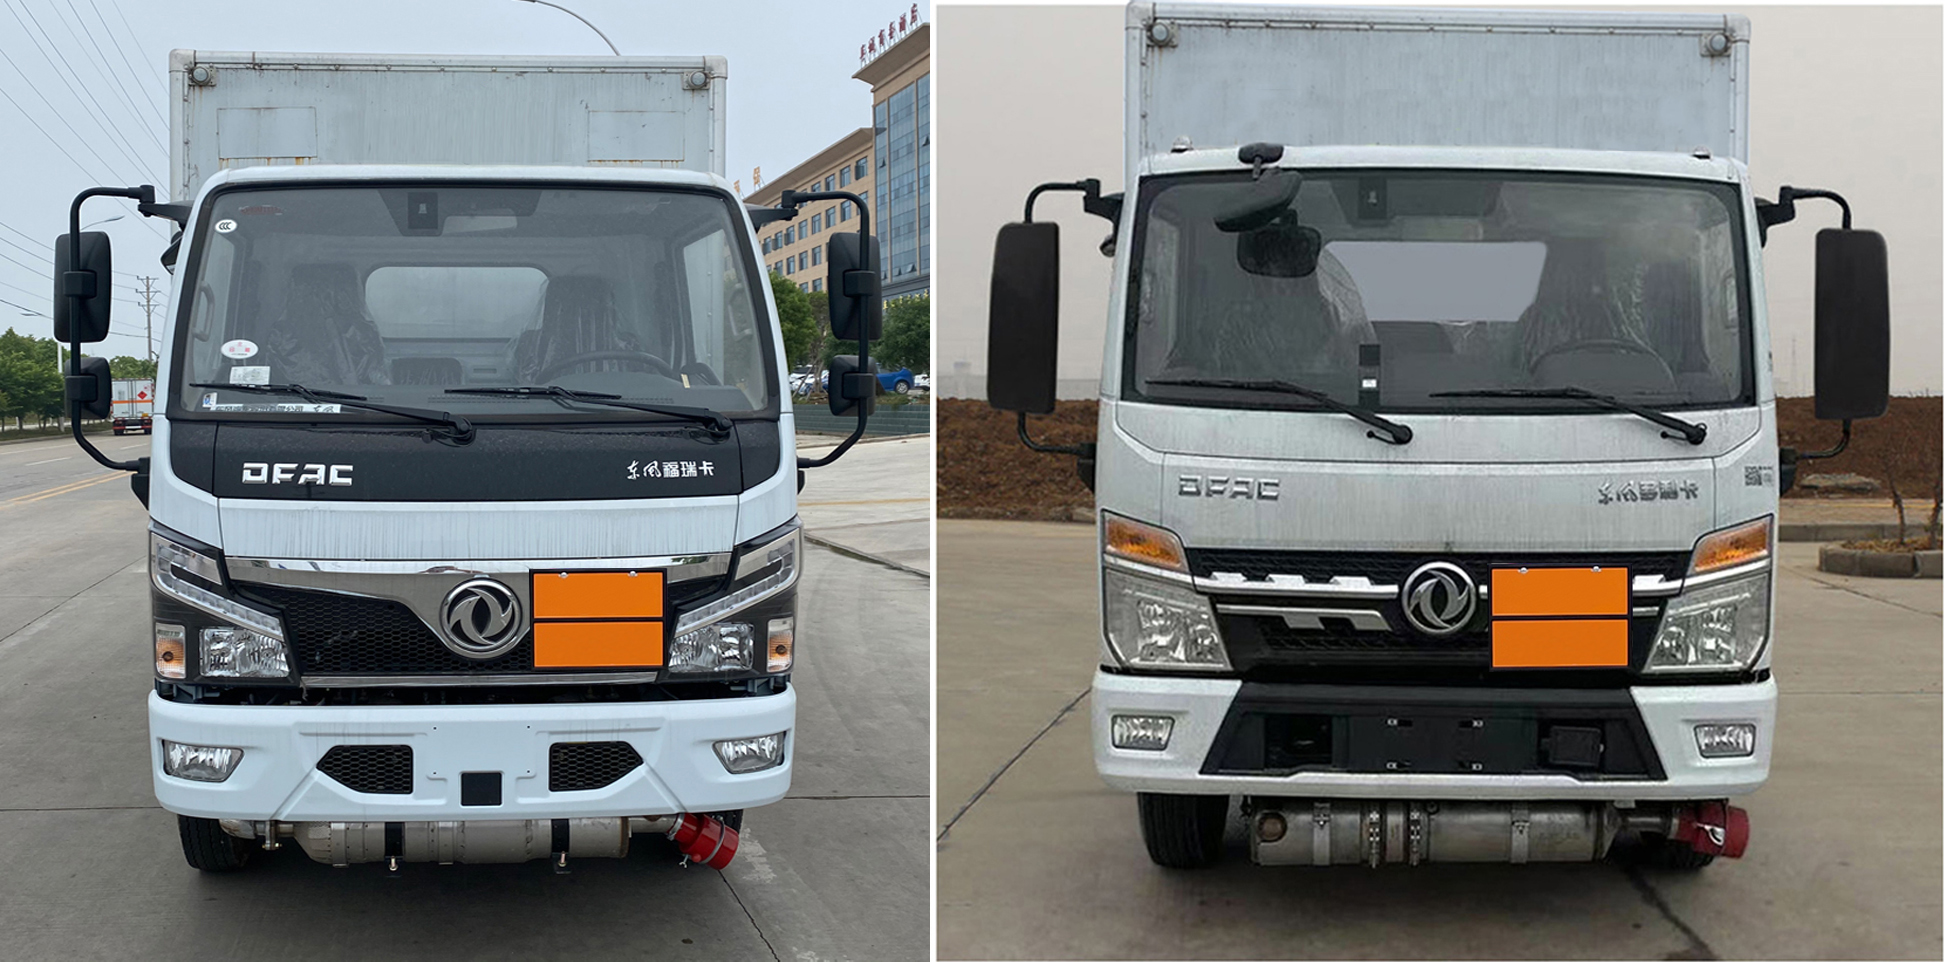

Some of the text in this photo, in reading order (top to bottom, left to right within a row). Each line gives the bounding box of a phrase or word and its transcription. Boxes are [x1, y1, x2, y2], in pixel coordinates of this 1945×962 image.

[242, 462, 353, 486] DFAC
[627, 460, 714, 480] 东风福瑞卡
[1178, 474, 1280, 501] DFAC
